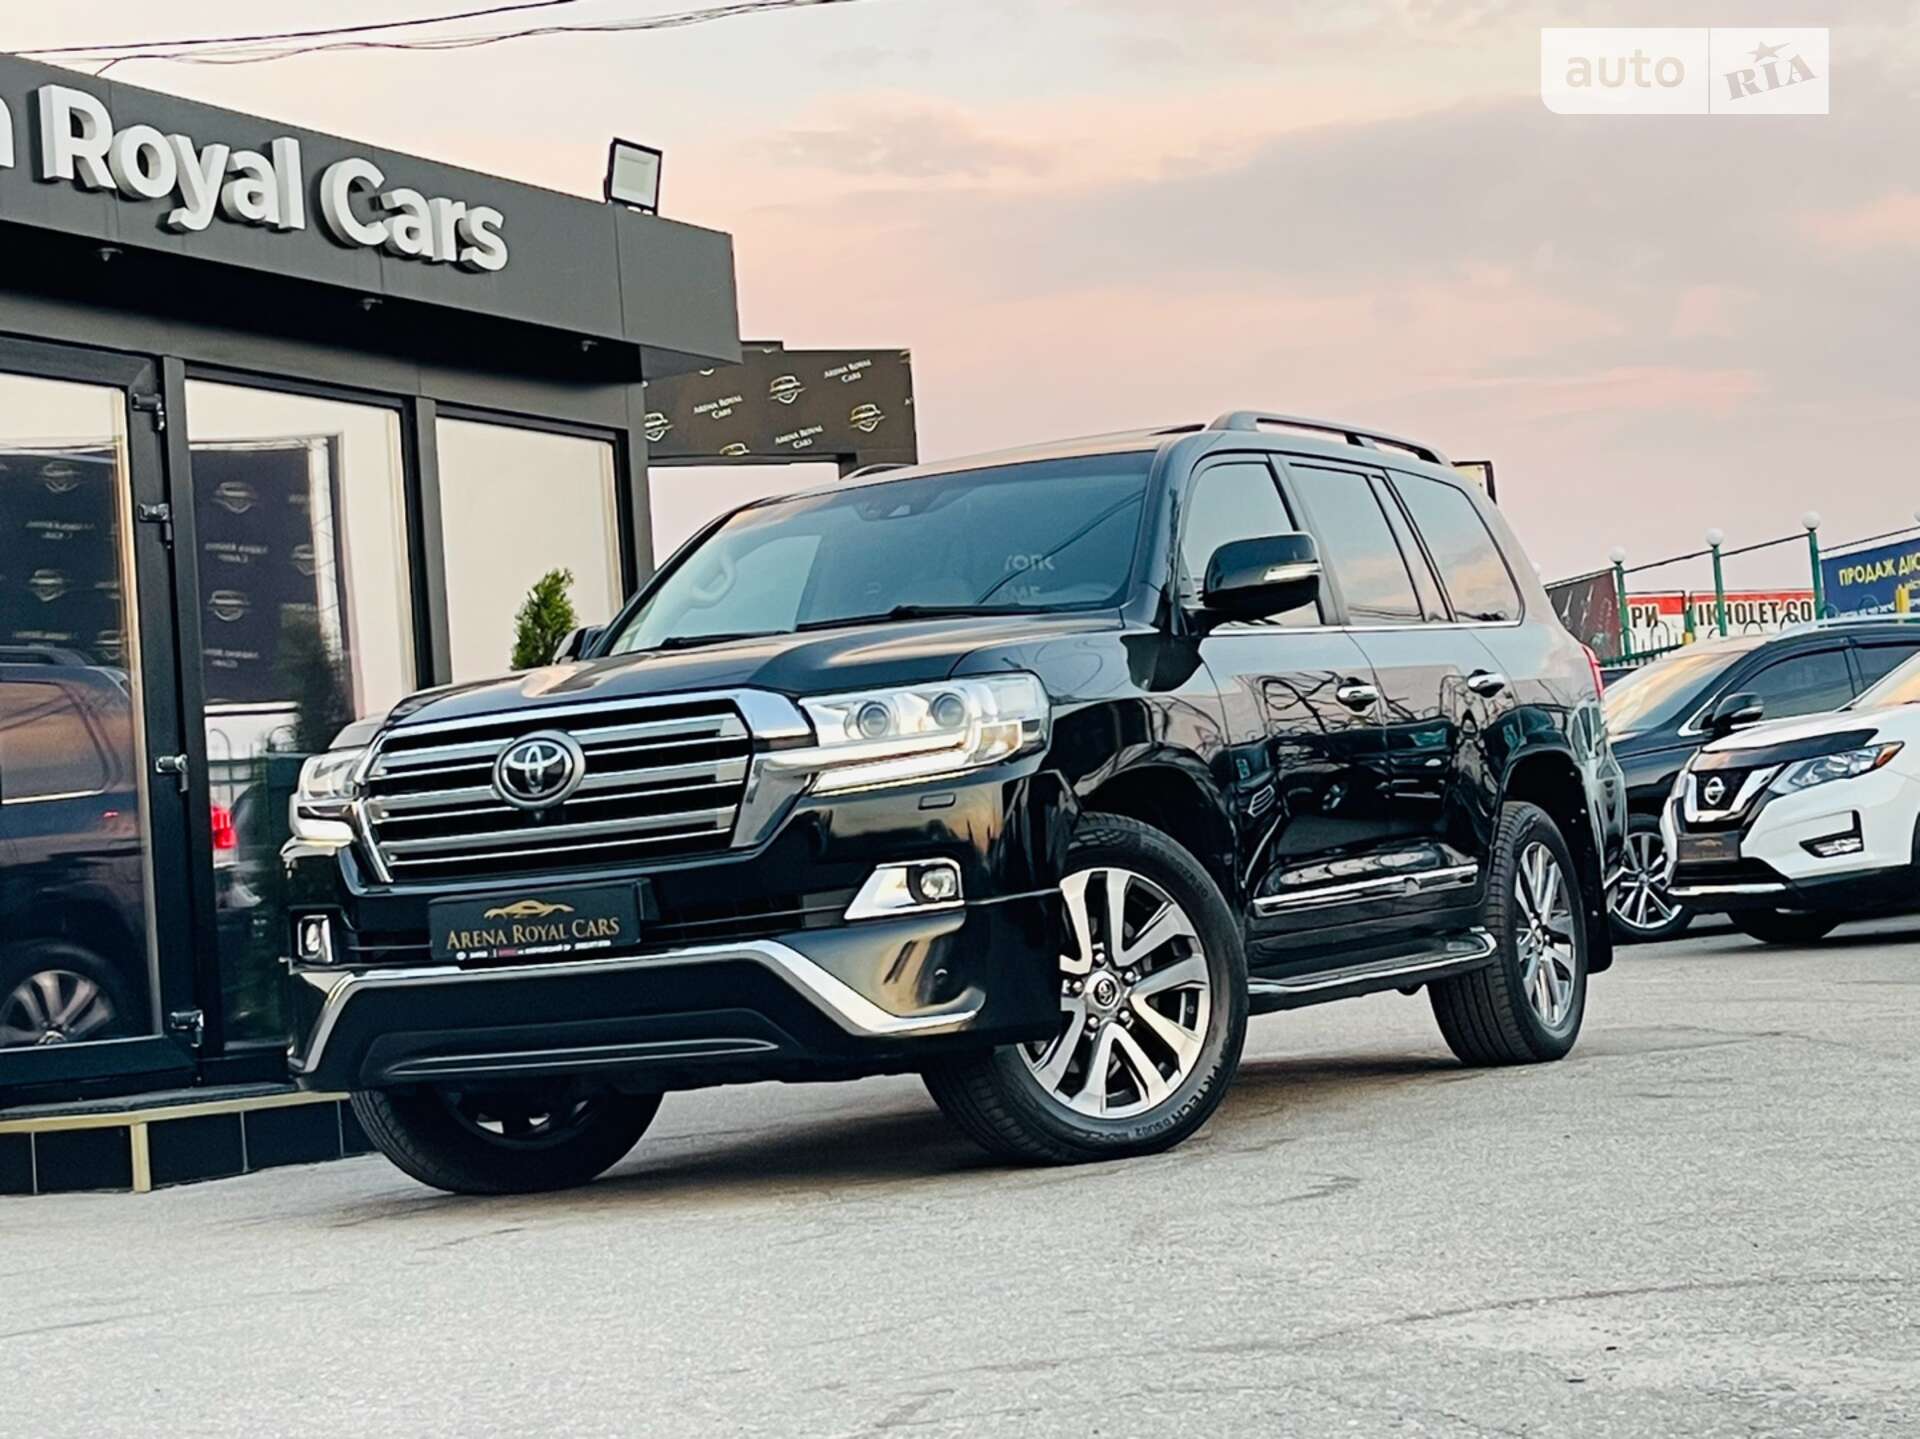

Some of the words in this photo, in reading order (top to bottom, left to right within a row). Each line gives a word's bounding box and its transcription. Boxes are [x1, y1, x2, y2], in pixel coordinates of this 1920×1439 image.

[38, 84, 305, 231] Royal
[320, 158, 508, 271] Cars
[1838, 557, 1896, 587] ПРОДАЖ
[447, 929, 508, 950] ARENA
[513, 922, 569, 944] ROYAL
[572, 917, 620, 938] CARS
